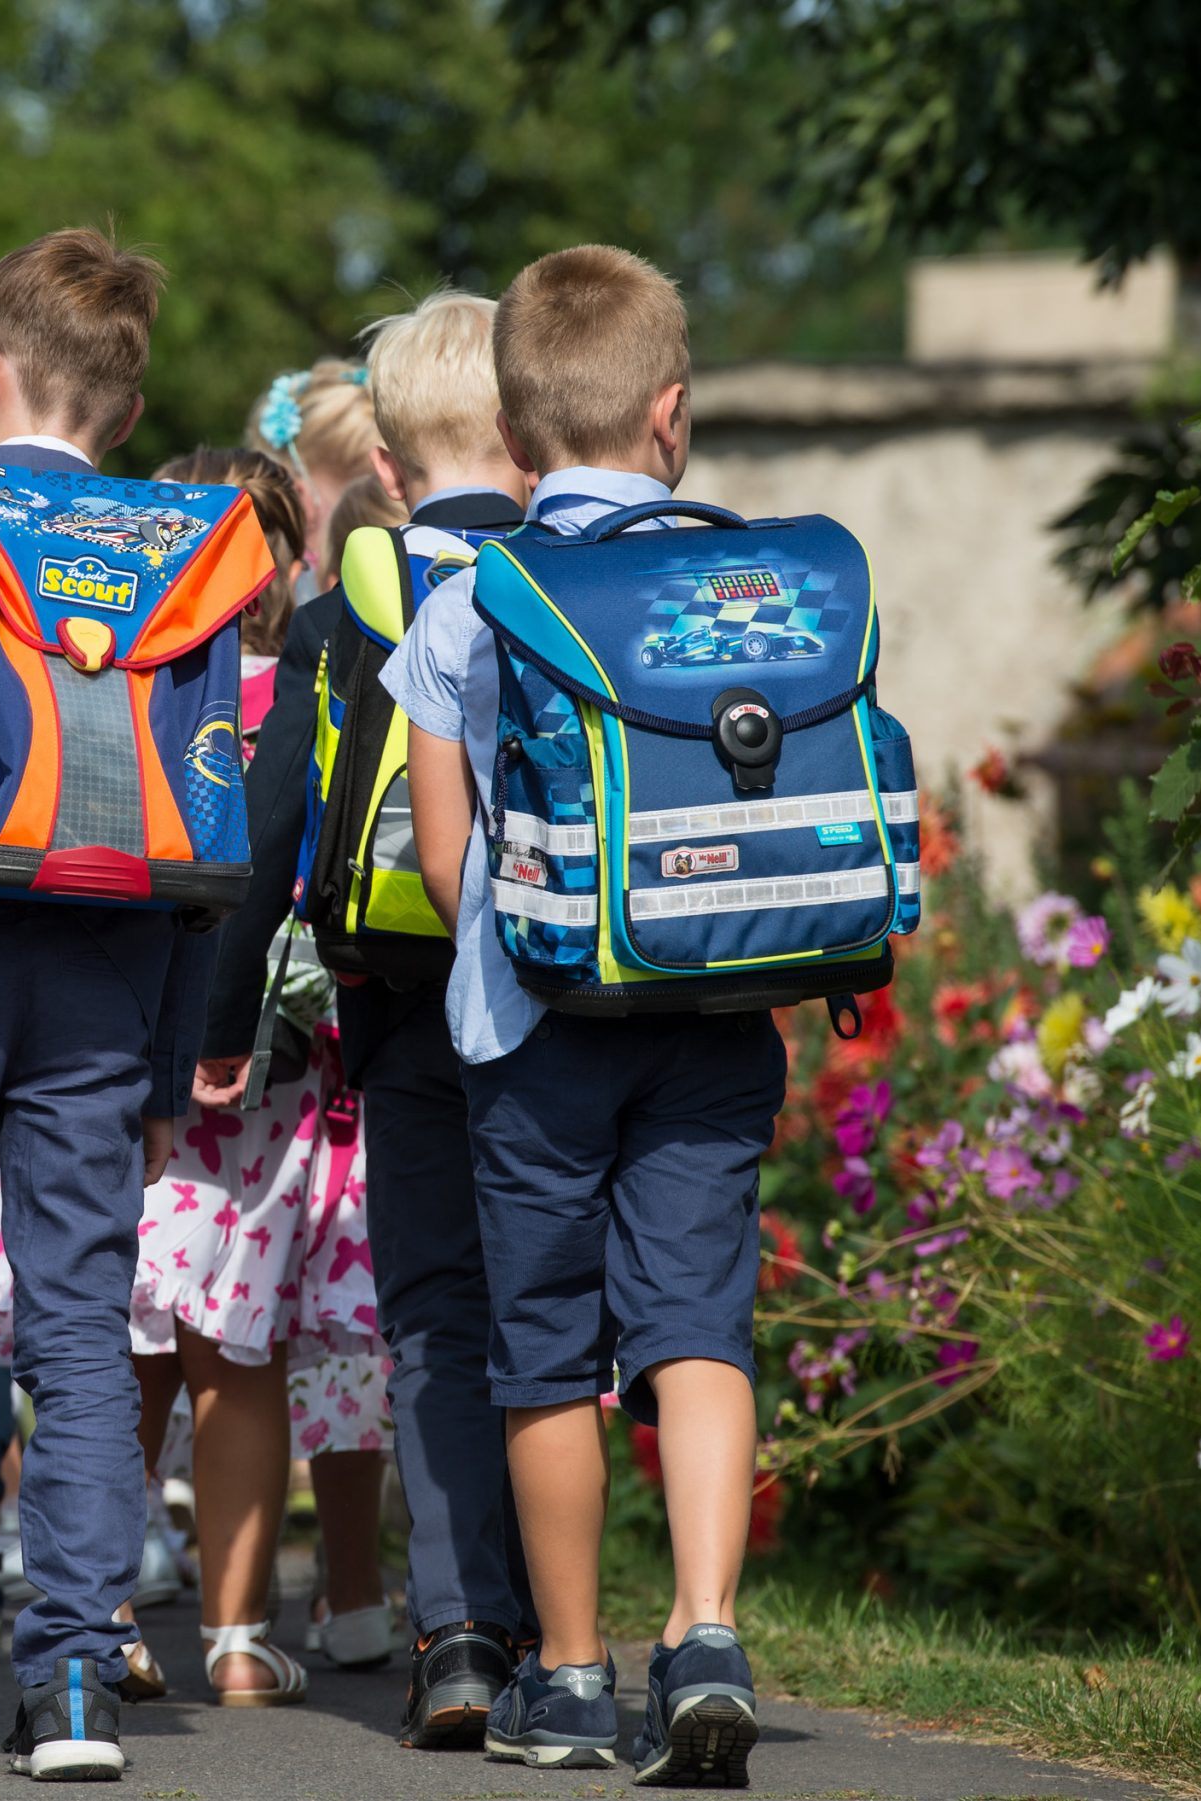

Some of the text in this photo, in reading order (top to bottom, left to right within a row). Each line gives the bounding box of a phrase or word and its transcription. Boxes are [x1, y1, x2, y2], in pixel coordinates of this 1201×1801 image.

[43, 567, 132, 605] Scout
[821, 824, 854, 835] SPEED
[697, 1627, 736, 1641] GEOX
[566, 1673, 602, 1683] GEOX
